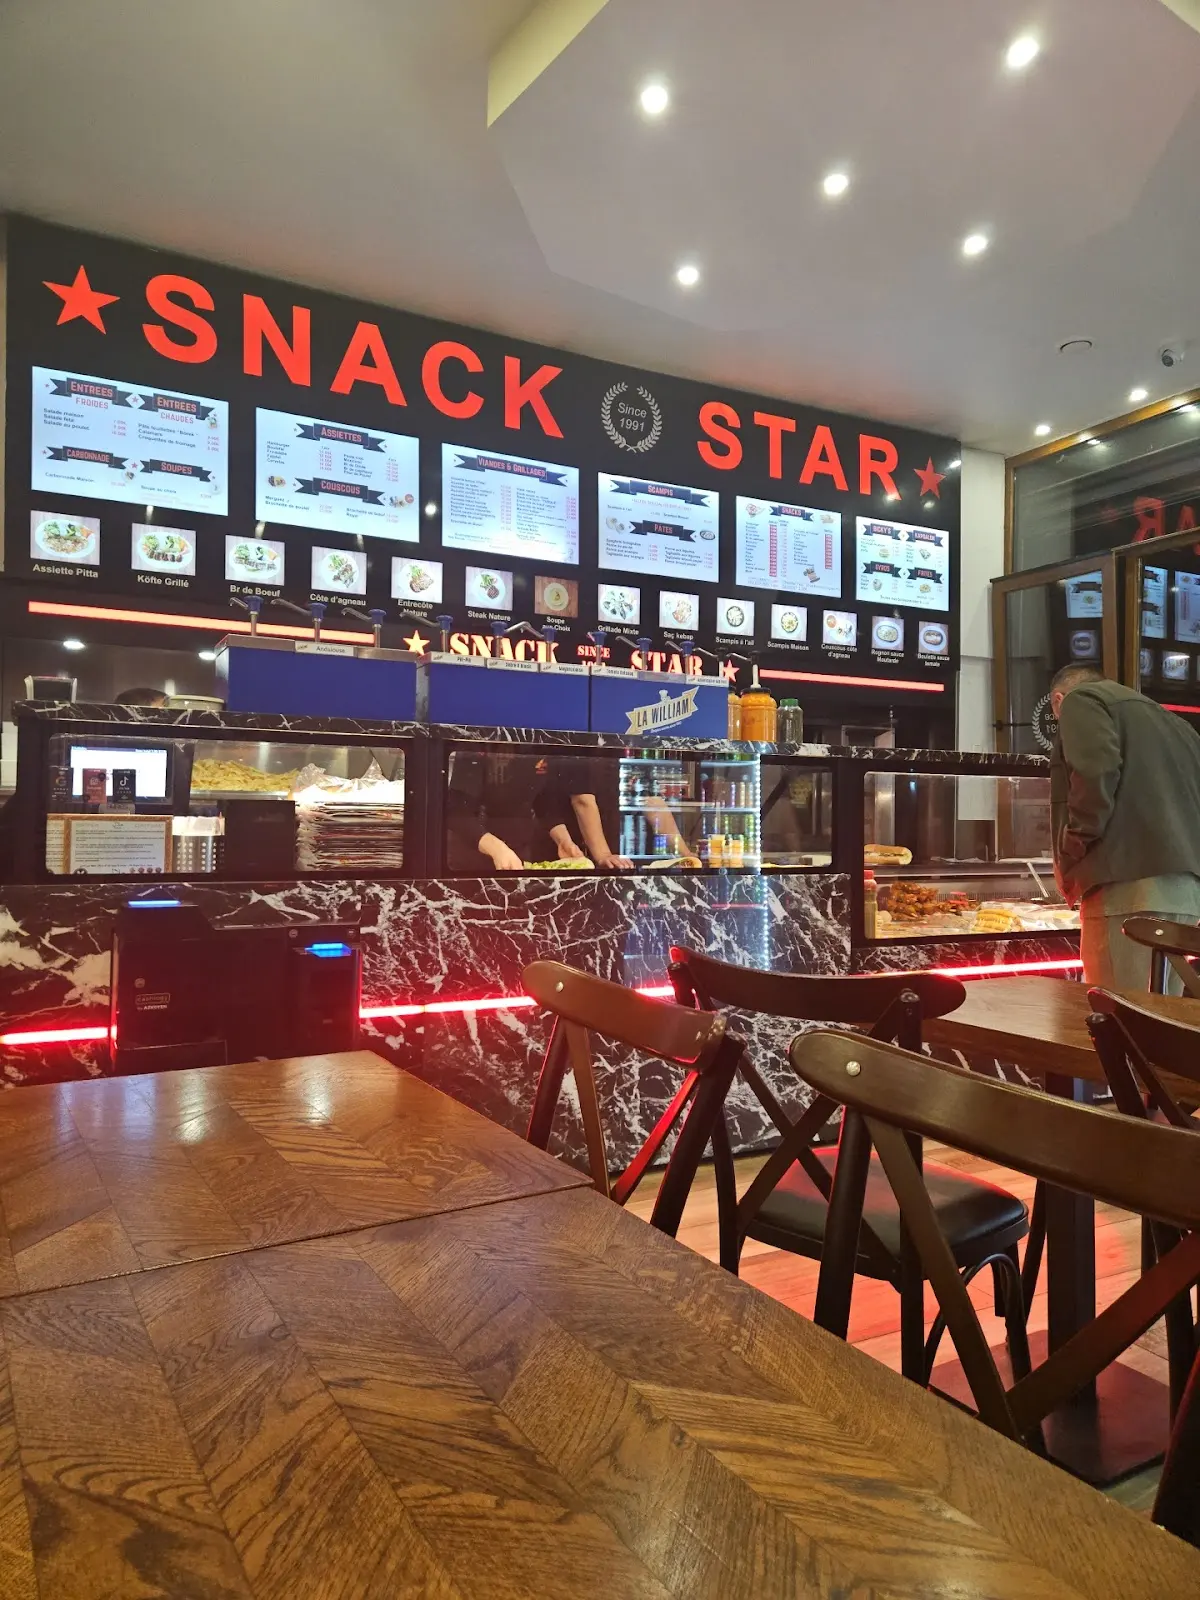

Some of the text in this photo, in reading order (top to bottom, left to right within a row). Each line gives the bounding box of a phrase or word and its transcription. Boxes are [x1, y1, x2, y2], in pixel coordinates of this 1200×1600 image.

[142, 273, 564, 438] SNACK
[75, 397, 109, 409] FROIDES
[618, 402, 647, 418] Since
[160, 411, 194, 424] CHAUDES
[620, 417, 645, 432] 1991
[321, 427, 361, 442] ASSIETTES
[66, 449, 110, 462] CARBONNADE
[697, 401, 902, 500] STAR
[160, 462, 192, 474] SOUPES
[478, 457, 505, 470] VIANDES
[321, 480, 361, 495] COUSCOUS
[647, 485, 674, 497] SCAMPIS
[781, 506, 802, 516] SNACKS
[33, 563, 98, 578] Assiette Pitta
[875, 564, 890, 572] GYROS
[917, 569, 933, 578] FRITES
[137, 574, 189, 588] Köfte Grillé
[230, 585, 241, 593] Br
[255, 587, 281, 598] Boeuf
[310, 593, 366, 606] Côte d'agneau
[398, 599, 433, 610] Entrecôte
[468, 610, 511, 622] Steak Nature
[546, 616, 565, 625] Soupe
[598, 625, 639, 636] Grillade Mixte
[715, 636, 739, 645] Scampis
[767, 641, 790, 650] Scampis
[821, 643, 846, 651] Couscous
[449, 633, 559, 664] SNACK
[630, 649, 703, 677] STAR
[637, 710, 648, 727] LA
[651, 698, 689, 724] WILLIAM
